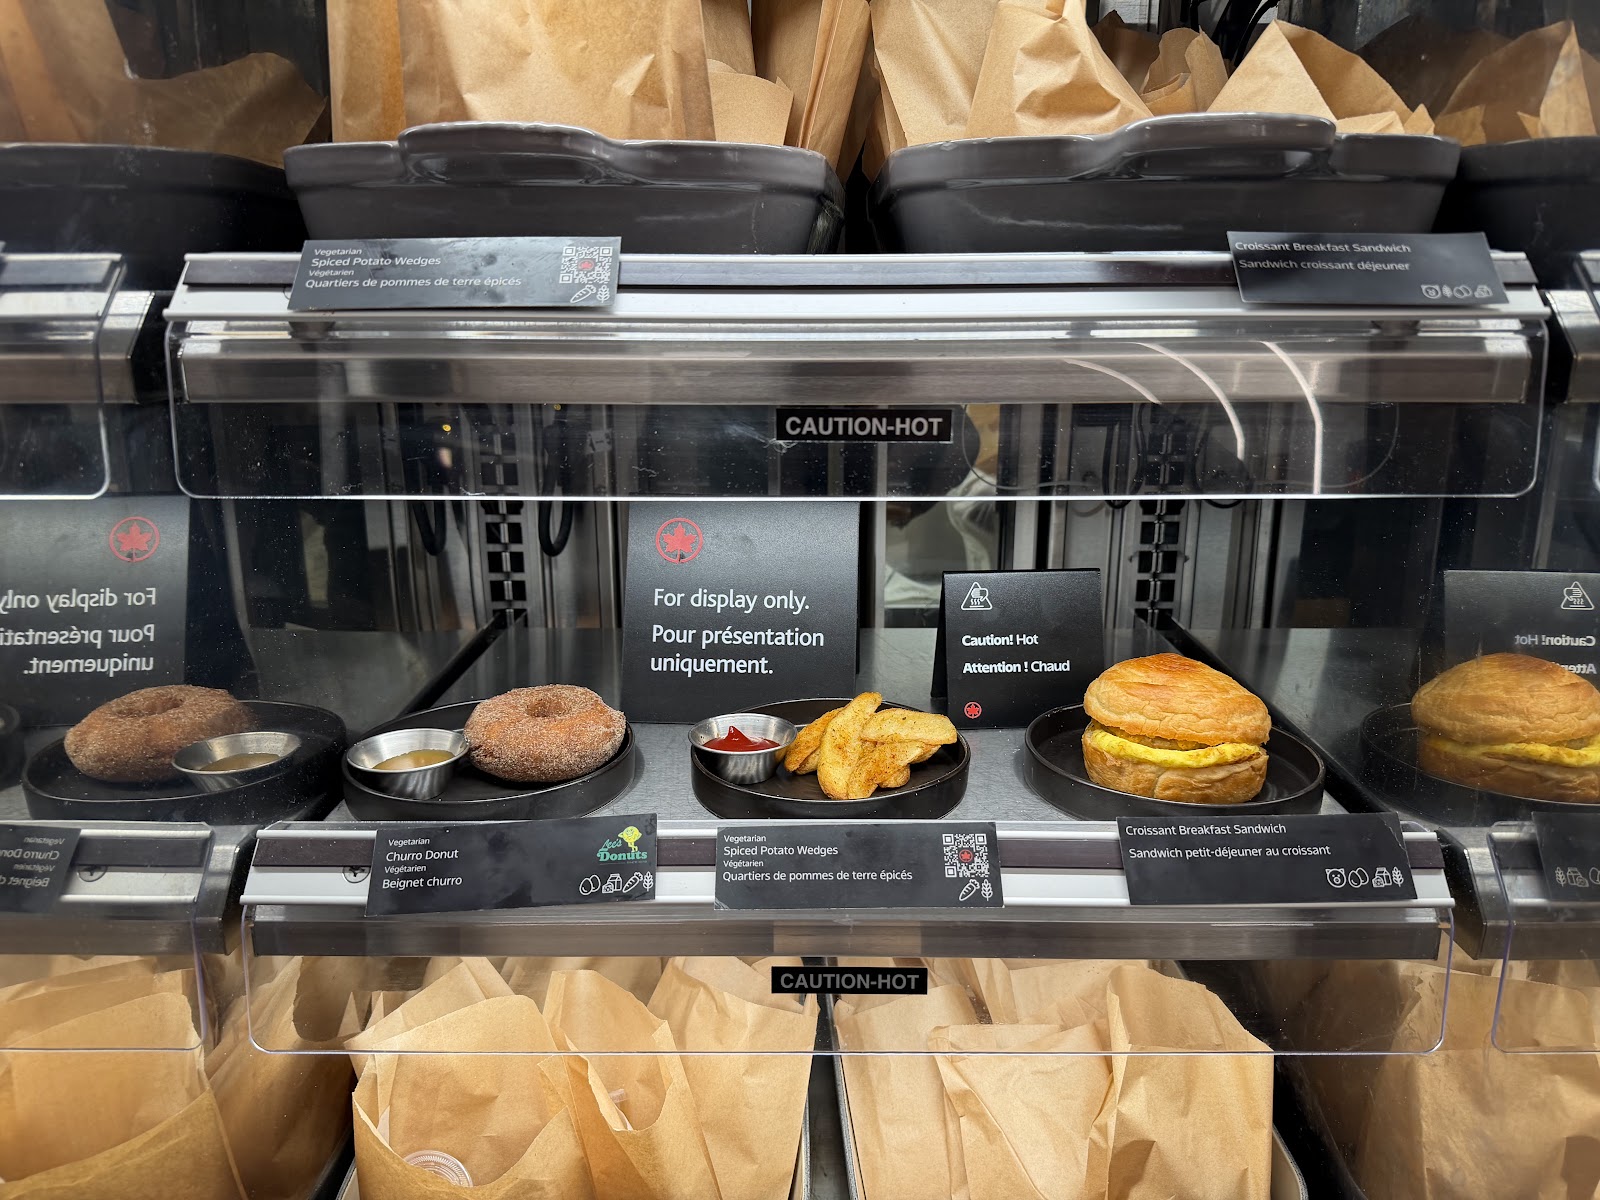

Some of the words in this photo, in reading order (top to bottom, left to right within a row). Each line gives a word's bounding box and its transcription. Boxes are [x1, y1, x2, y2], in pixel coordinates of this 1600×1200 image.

[314, 248, 363, 256] Vegetarian
[1235, 241, 1291, 251] Croissant
[1293, 243, 1349, 253] Breakfast
[1352, 243, 1411, 253] Sandwich
[311, 257, 350, 267] Spiced
[353, 256, 392, 266] Potato
[394, 256, 441, 267] Wedges
[1239, 259, 1298, 269] Sandwich
[1300, 261, 1355, 270] croissant
[1357, 260, 1411, 272] déjeuner
[309, 269, 354, 277] Végétarien
[305, 278, 360, 289] Quartiers
[362, 277, 377, 287] de
[380, 279, 431, 289] pommes
[434, 277, 449, 287] de
[452, 277, 481, 286] terre
[484, 276, 522, 288] épicés
[785, 416, 943, 437] CAUTION-HOT
[653, 588, 685, 606] For
[690, 588, 757, 613] display
[763, 590, 810, 614] only.
[651, 625, 697, 645] Pour
[701, 625, 824, 649] présentation
[962, 634, 1014, 647] Caution!
[1016, 634, 1039, 646] Hot
[650, 653, 774, 676] uniquement.
[1030, 661, 1070, 673] Chaud
[1125, 825, 1177, 836] Croissant
[1179, 824, 1232, 835] Breakfast
[1233, 823, 1287, 834] Sandwich
[388, 837, 430, 847] Vegetarian
[599, 838, 622, 851] Lee's
[724, 834, 767, 844] Vegetarian
[386, 851, 423, 862] Churro
[425, 849, 459, 860] Donut
[597, 850, 648, 862] Donuts
[723, 846, 758, 856] Spiced
[760, 845, 794, 855] Potato
[797, 845, 838, 857] Wedges
[1129, 847, 1183, 858] Sandwich
[1185, 847, 1263, 859] petit-déjeuner
[1265, 848, 1281, 856] au
[1282, 845, 1331, 855] croissant
[384, 864, 426, 875] Végétarien
[723, 859, 764, 869] Végétarien
[382, 877, 424, 890] Beignet
[427, 875, 462, 886] churro
[722, 871, 771, 882] Quartiers
[773, 871, 786, 880] de
[789, 872, 834, 883] pommes
[836, 870, 849, 880] de
[852, 871, 877, 880] terre
[880, 870, 913, 881] épicés
[780, 973, 919, 989] CAUTION-HOT
